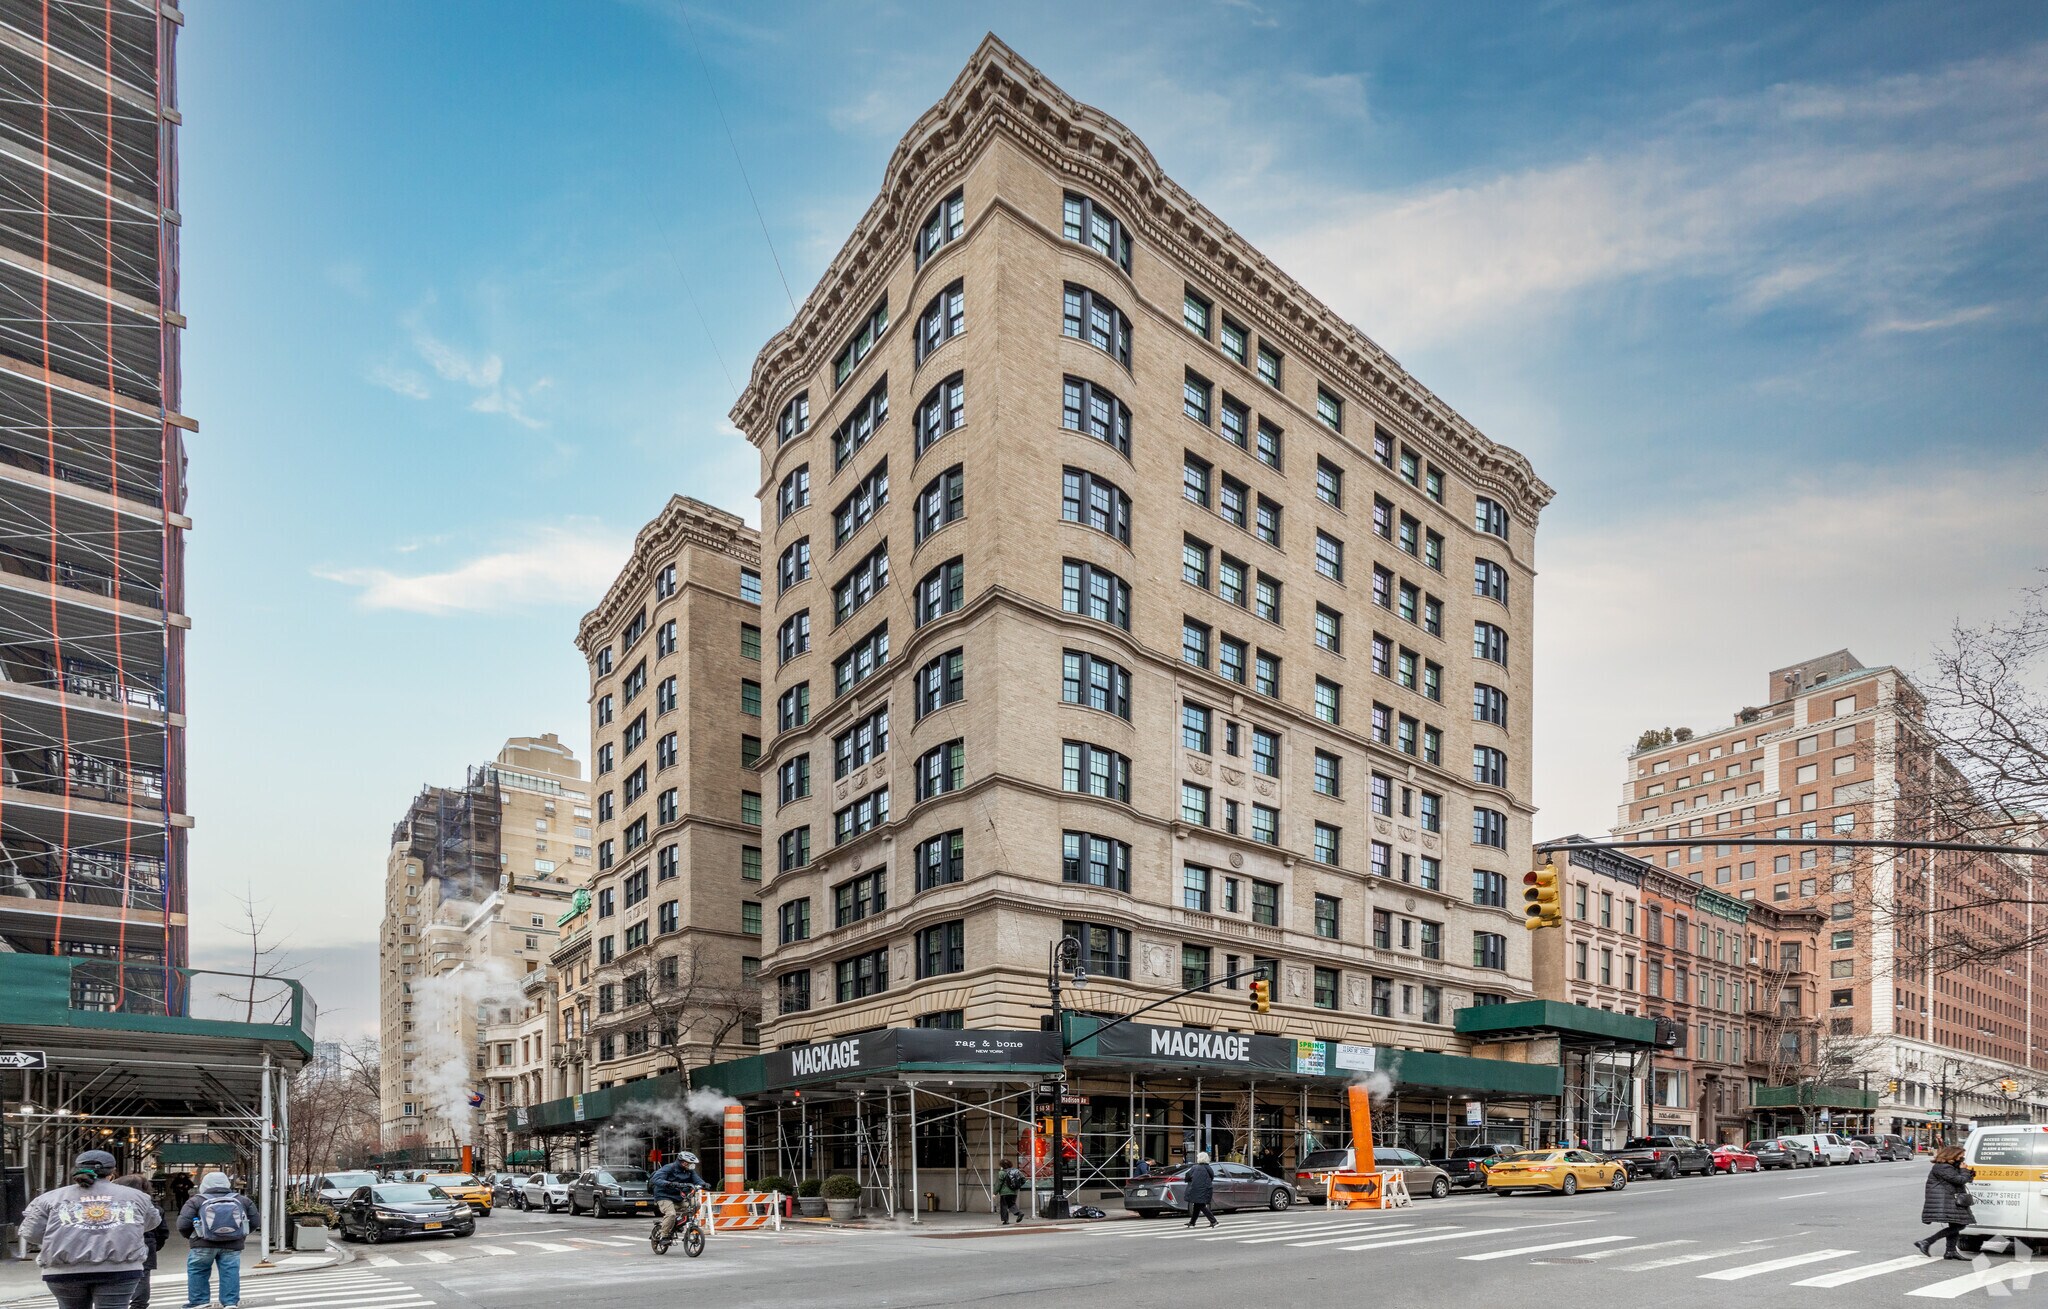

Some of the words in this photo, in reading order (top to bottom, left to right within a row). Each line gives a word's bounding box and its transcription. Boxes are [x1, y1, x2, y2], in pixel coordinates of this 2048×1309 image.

[955, 1040, 976, 1048] rag
[996, 1040, 1023, 1048] bone
[1151, 1029, 1250, 1061] MACKAGE
[1299, 1041, 1325, 1050] SPRING
[792, 1039, 860, 1076] MACKAGE
[1061, 1096, 1080, 1104] Madison
